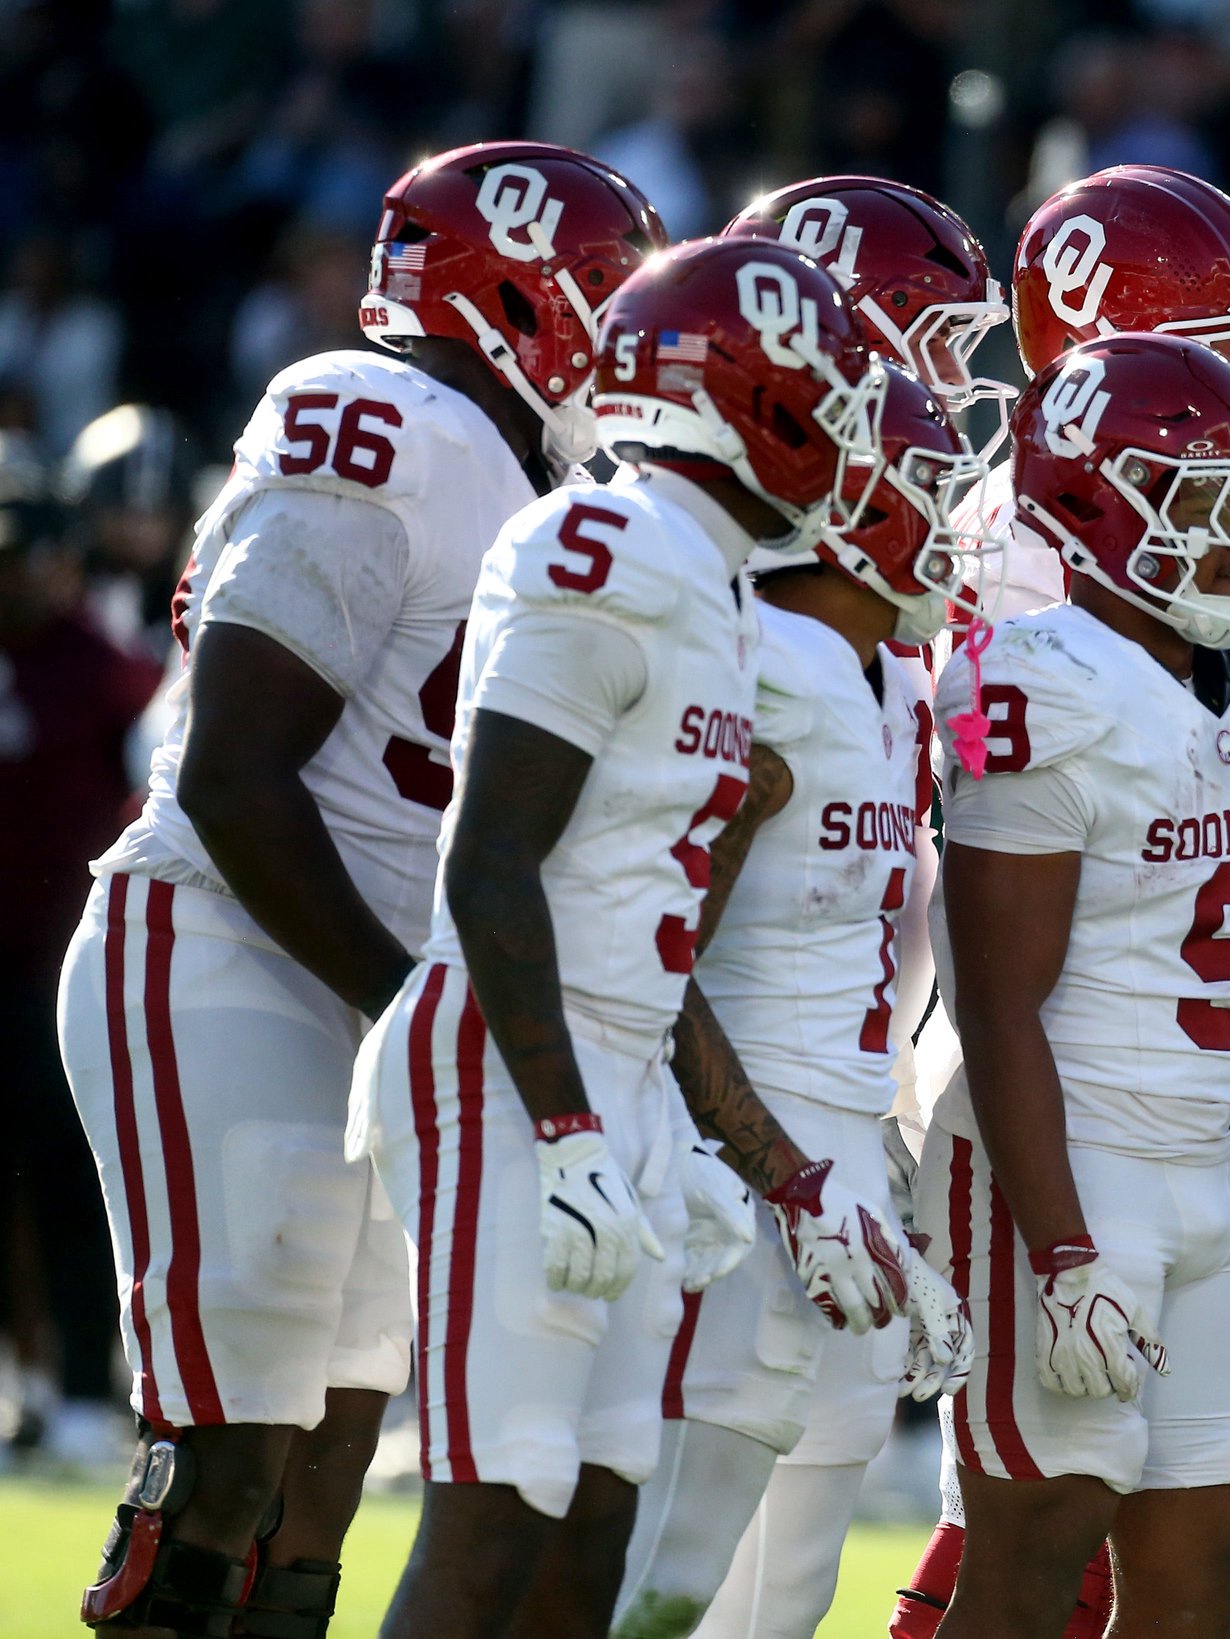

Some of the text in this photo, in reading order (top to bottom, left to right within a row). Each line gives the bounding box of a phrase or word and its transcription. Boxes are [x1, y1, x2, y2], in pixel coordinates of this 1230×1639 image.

[475, 163, 563, 262] OU
[736, 261, 821, 368] OU
[1042, 213, 1113, 329] OU
[614, 334, 639, 382] 5
[279, 393, 404, 489] 56
[1041, 357, 1112, 459] OU
[547, 502, 629, 594] 5
